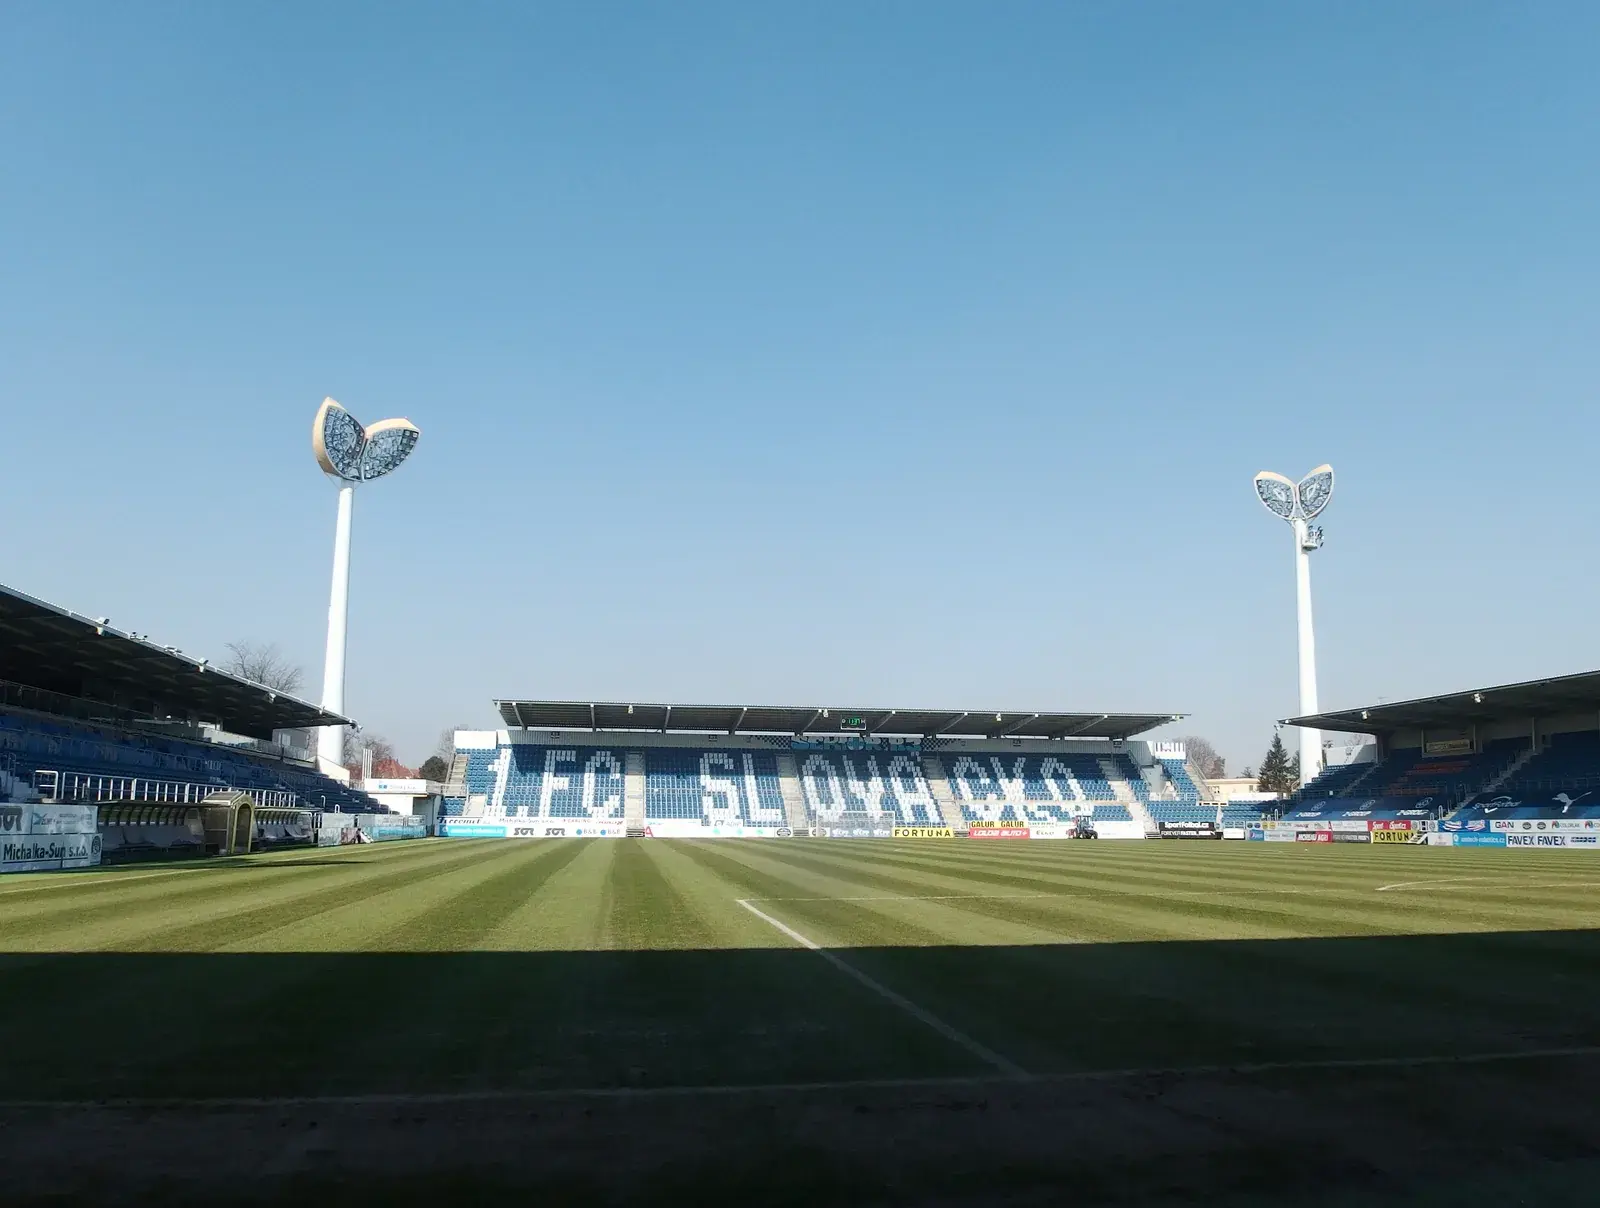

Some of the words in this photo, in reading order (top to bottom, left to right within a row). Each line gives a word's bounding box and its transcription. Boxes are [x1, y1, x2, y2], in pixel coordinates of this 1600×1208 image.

[0, 806, 23, 832] OR
[1495, 821, 1514, 829] GAN
[894, 829, 951, 837] FORTUNA
[1507, 835, 1535, 845] FAVEX
[1537, 835, 1566, 846] FAVEX
[3, 842, 66, 860] Michalka-Sun
[68, 845, 88, 857] s.r.o.
